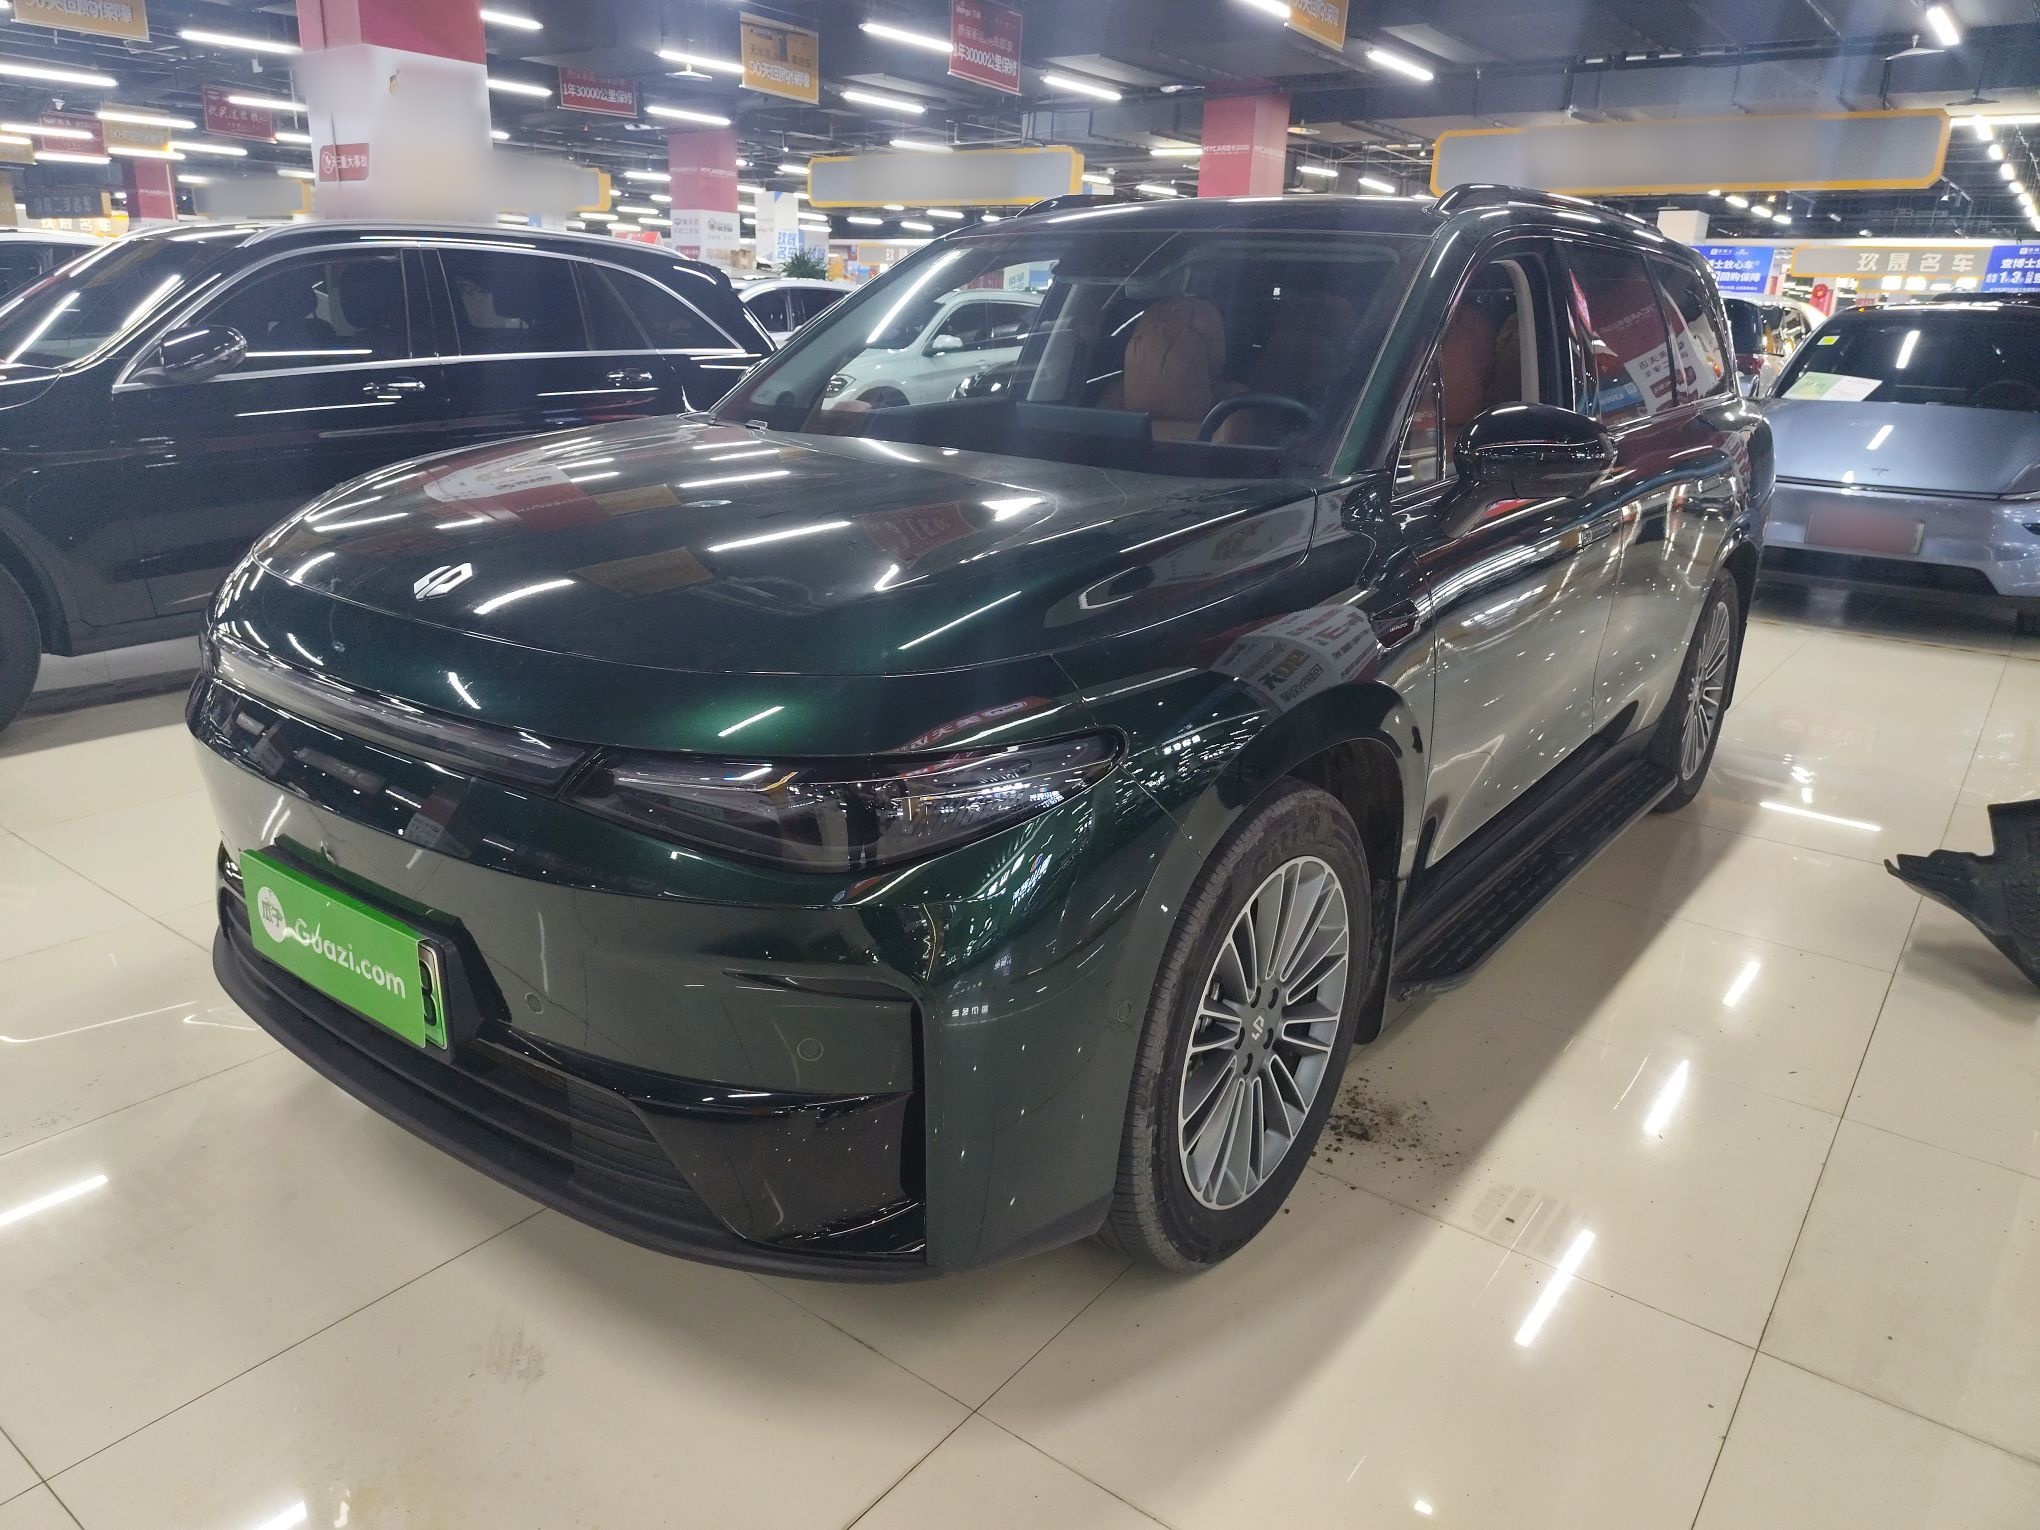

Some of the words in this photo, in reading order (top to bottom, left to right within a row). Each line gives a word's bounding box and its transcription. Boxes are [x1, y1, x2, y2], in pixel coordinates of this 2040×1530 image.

[563, 83, 633, 105] 1年30000公里保修
[1856, 252, 1976, 273] 玖晟名车
